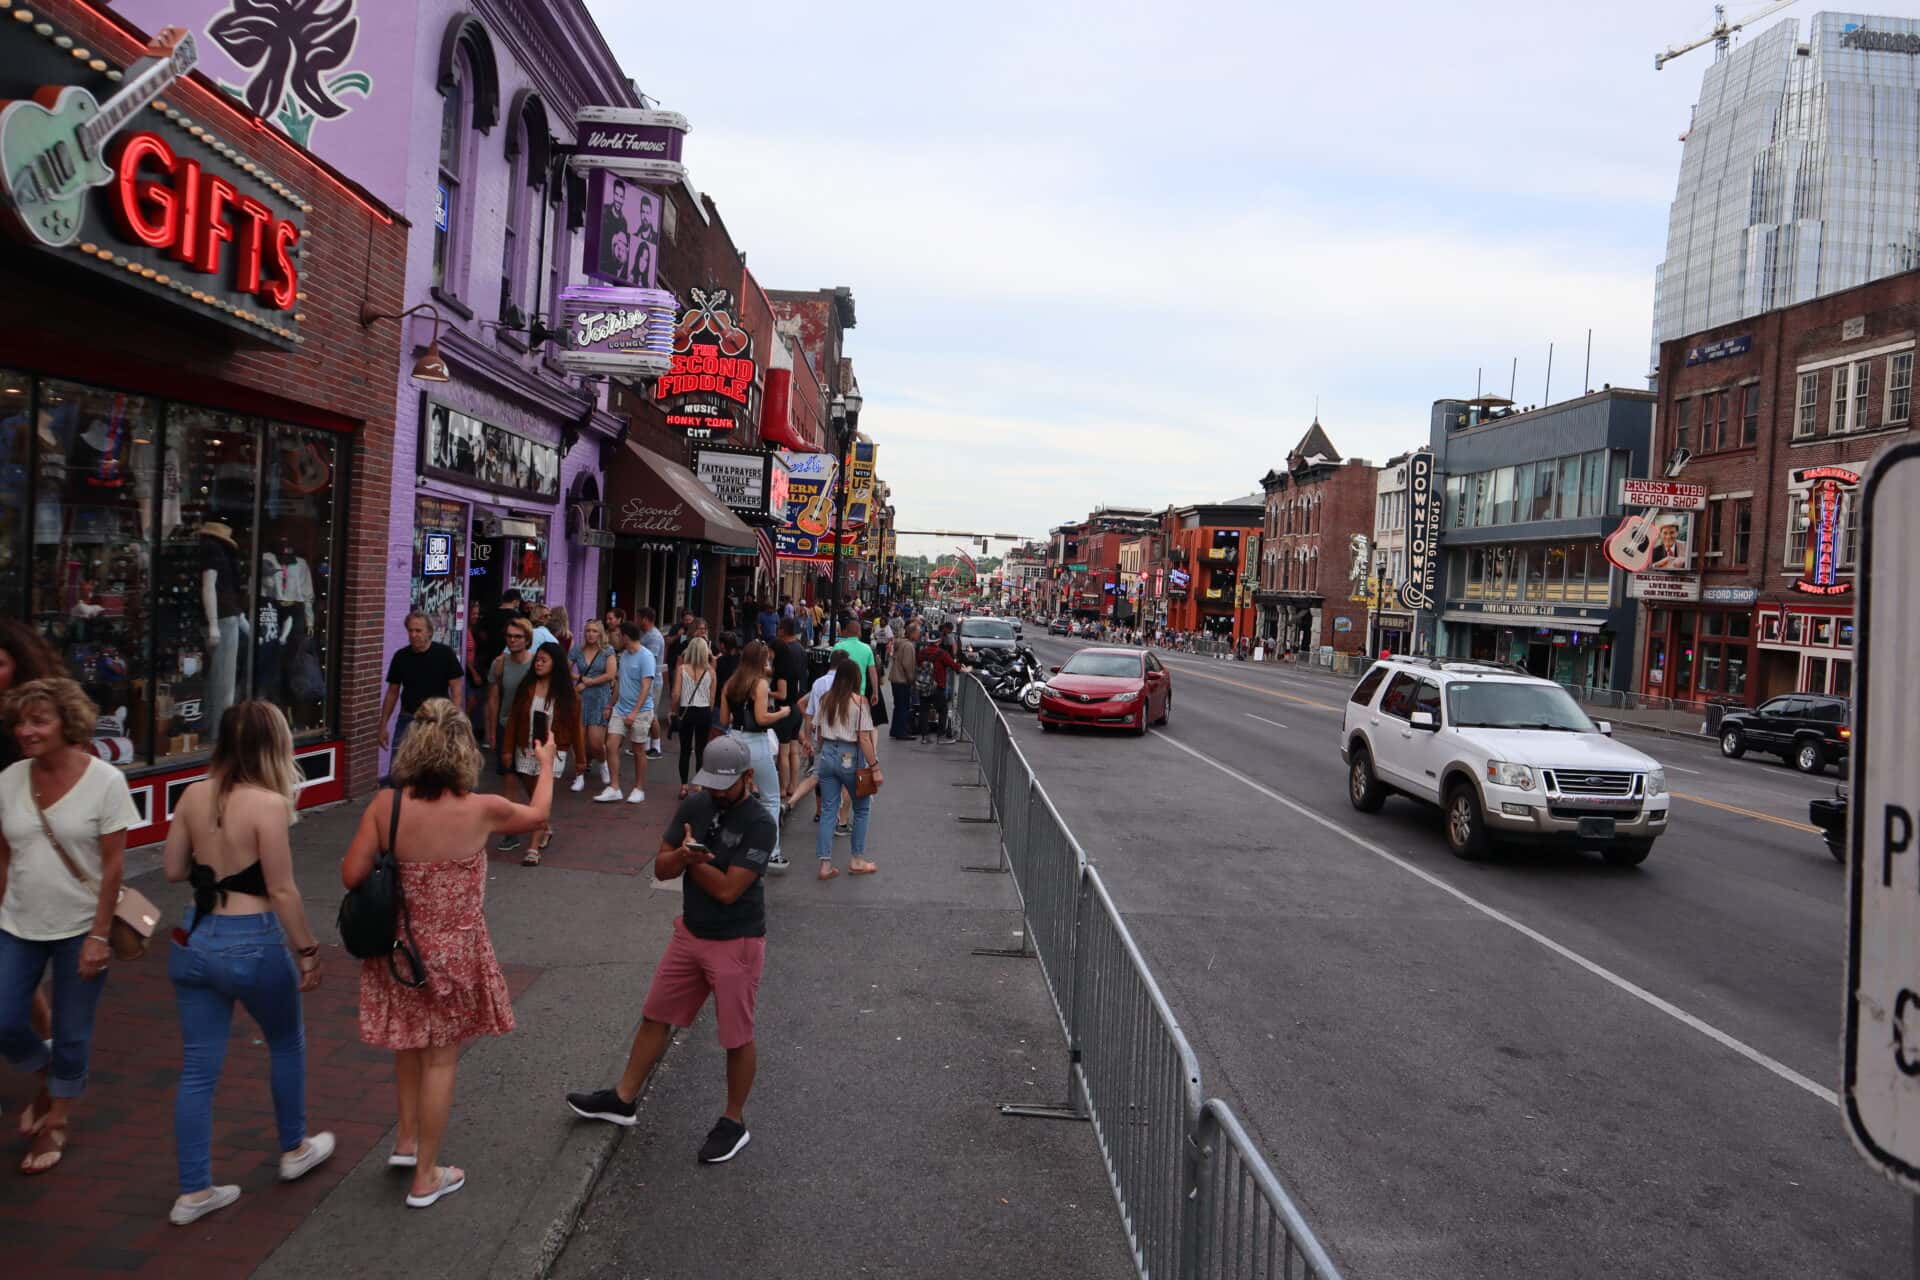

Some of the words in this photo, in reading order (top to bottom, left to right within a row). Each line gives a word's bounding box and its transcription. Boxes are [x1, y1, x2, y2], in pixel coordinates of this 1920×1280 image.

[588, 132, 623, 149] World
[623, 133, 666, 152] Famous
[115, 131, 302, 311] GIFTS
[692, 344, 718, 356] THE
[670, 354, 755, 382] ECOND
[657, 374, 748, 404] FIDDLE
[684, 404, 719, 415] MUSIC
[666, 415, 701, 427] HONKY
[704, 417, 734, 428] TONK
[687, 427, 711, 438] CITY
[712, 475, 750, 486] NASHVILLE
[790, 484, 818, 494] ERN
[851, 478, 871, 489] US
[1626, 479, 1671, 494] ERNEST
[1676, 484, 1705, 496] TUBB
[716, 484, 745, 495] THANKS
[621, 497, 683, 516] Second
[727, 495, 761, 505] WORKERS
[1631, 493, 1669, 506] RECORD
[1673, 496, 1699, 509] SHOP
[619, 513, 682, 532] Fiddle
[1413, 460, 1428, 584] DOWNTOWN
[1428, 500, 1441, 557] SPORTING
[1819, 481, 1835, 584] CROSSROADS
[429, 537, 447, 554] BUD
[641, 542, 674, 551] ATM
[424, 553, 449, 571] LIGHT
[1425, 560, 1437, 591] CLUB
[1732, 590, 1754, 601] SHOP
[1882, 803, 1920, 894] P
